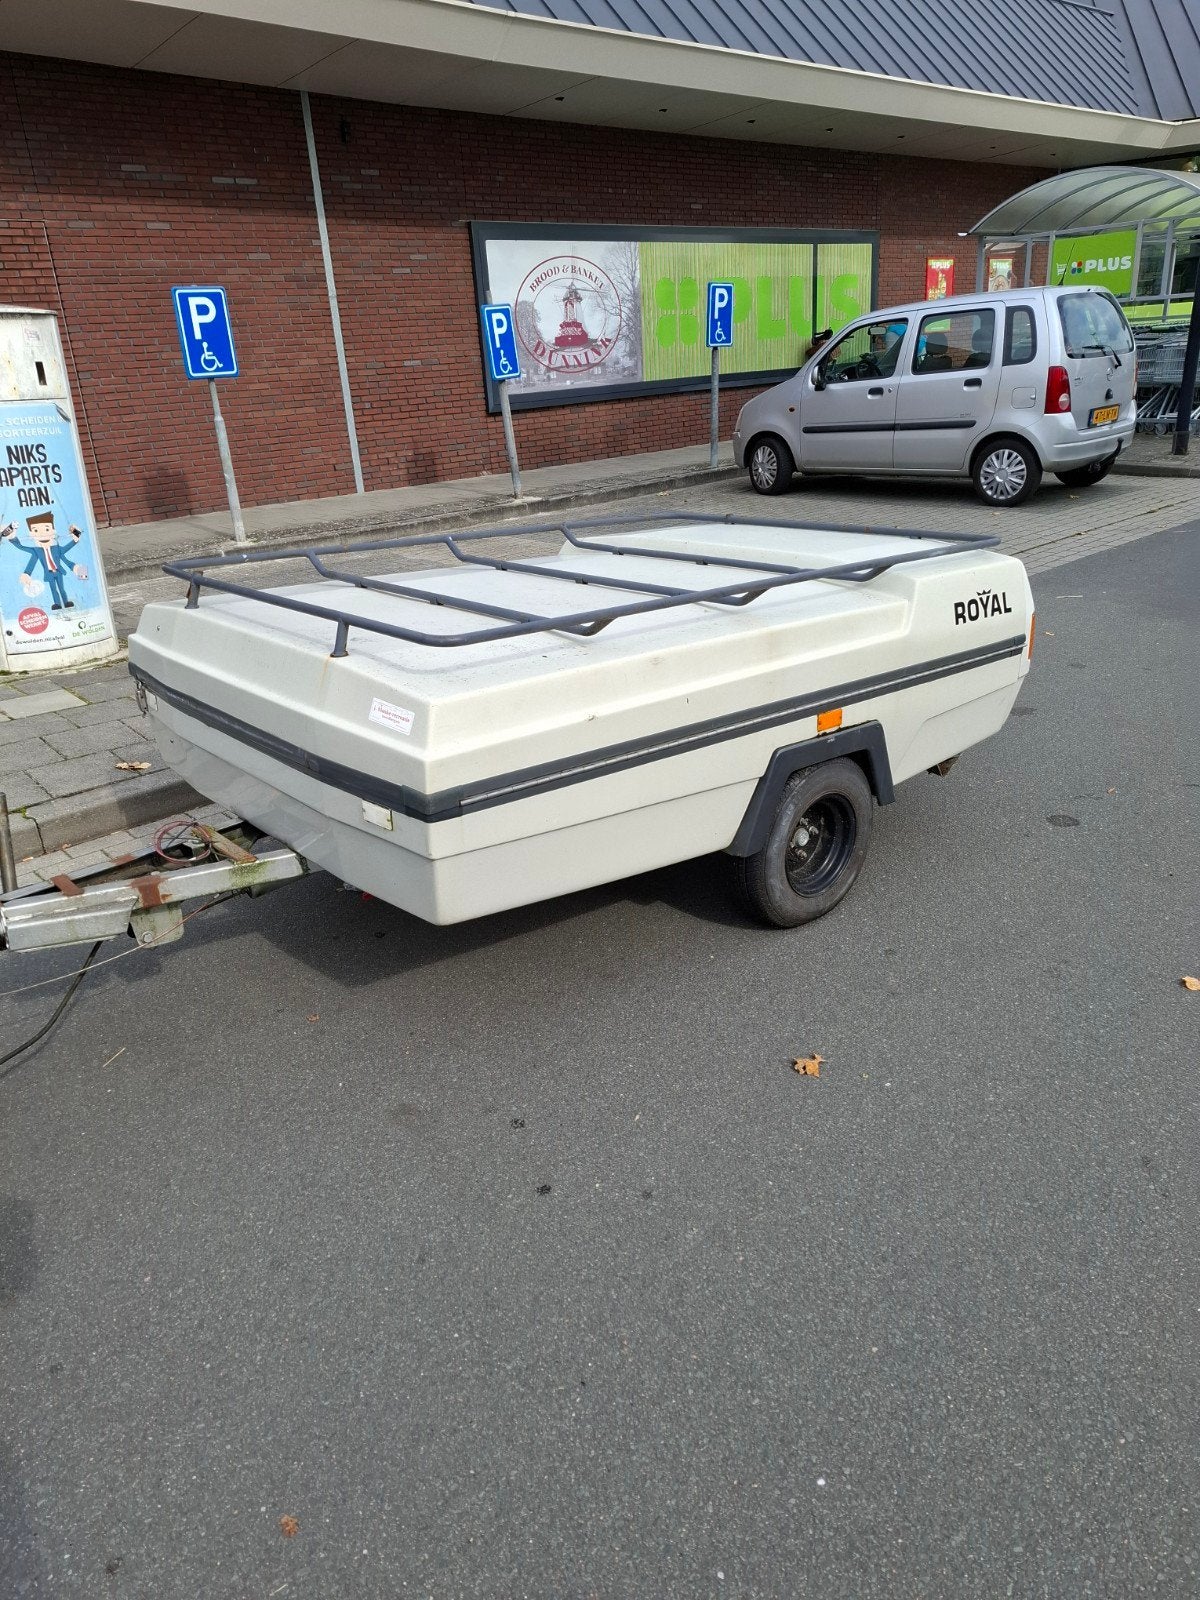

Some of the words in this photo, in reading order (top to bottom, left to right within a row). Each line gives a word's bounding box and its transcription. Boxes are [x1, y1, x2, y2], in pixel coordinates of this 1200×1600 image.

[1084, 255, 1132, 273] PLUS
[529, 266, 560, 292] BROOD
[562, 265, 569, 274] &
[571, 265, 605, 289] BANKET
[714, 287, 728, 319] P
[188, 296, 217, 340] P
[491, 312, 508, 348] P
[5, 415, 56, 426] SCHEIDEN
[6, 443, 47, 465] NIKS
[0, 463, 62, 487] APARTS
[17, 485, 54, 507] AAN.
[954, 591, 1012, 625] ROYAL
